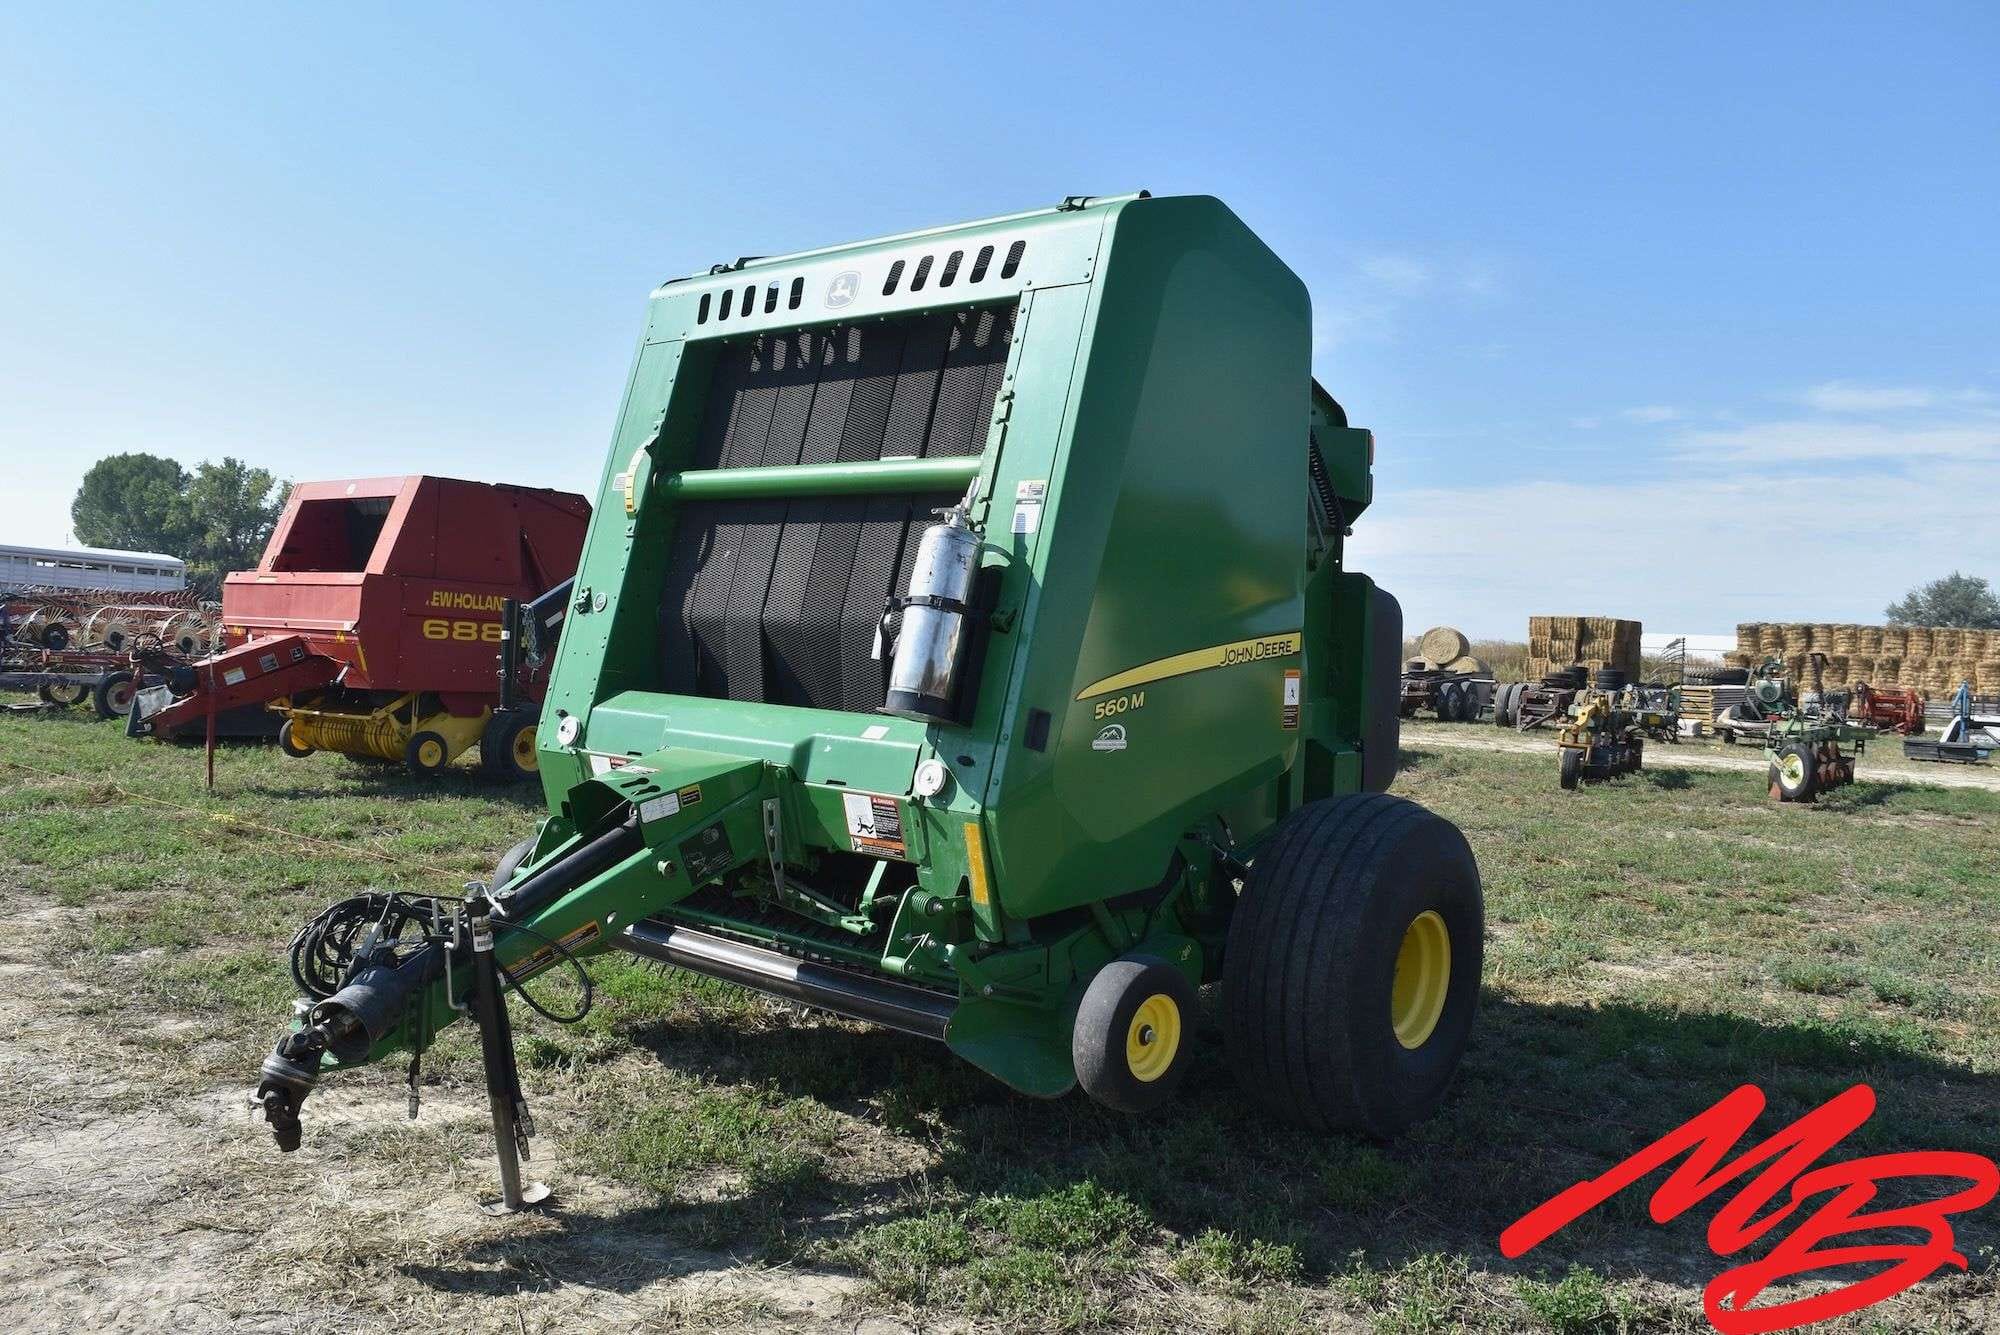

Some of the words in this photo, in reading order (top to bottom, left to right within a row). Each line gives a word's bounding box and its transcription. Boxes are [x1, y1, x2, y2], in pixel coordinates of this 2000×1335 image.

[425, 591, 453, 608] EW
[423, 619, 504, 642] 688
[1220, 647, 1253, 664] JOHN
[1255, 640, 1292, 657] DEERE
[1094, 696, 1129, 720] 560
[1131, 691, 1145, 709] M
